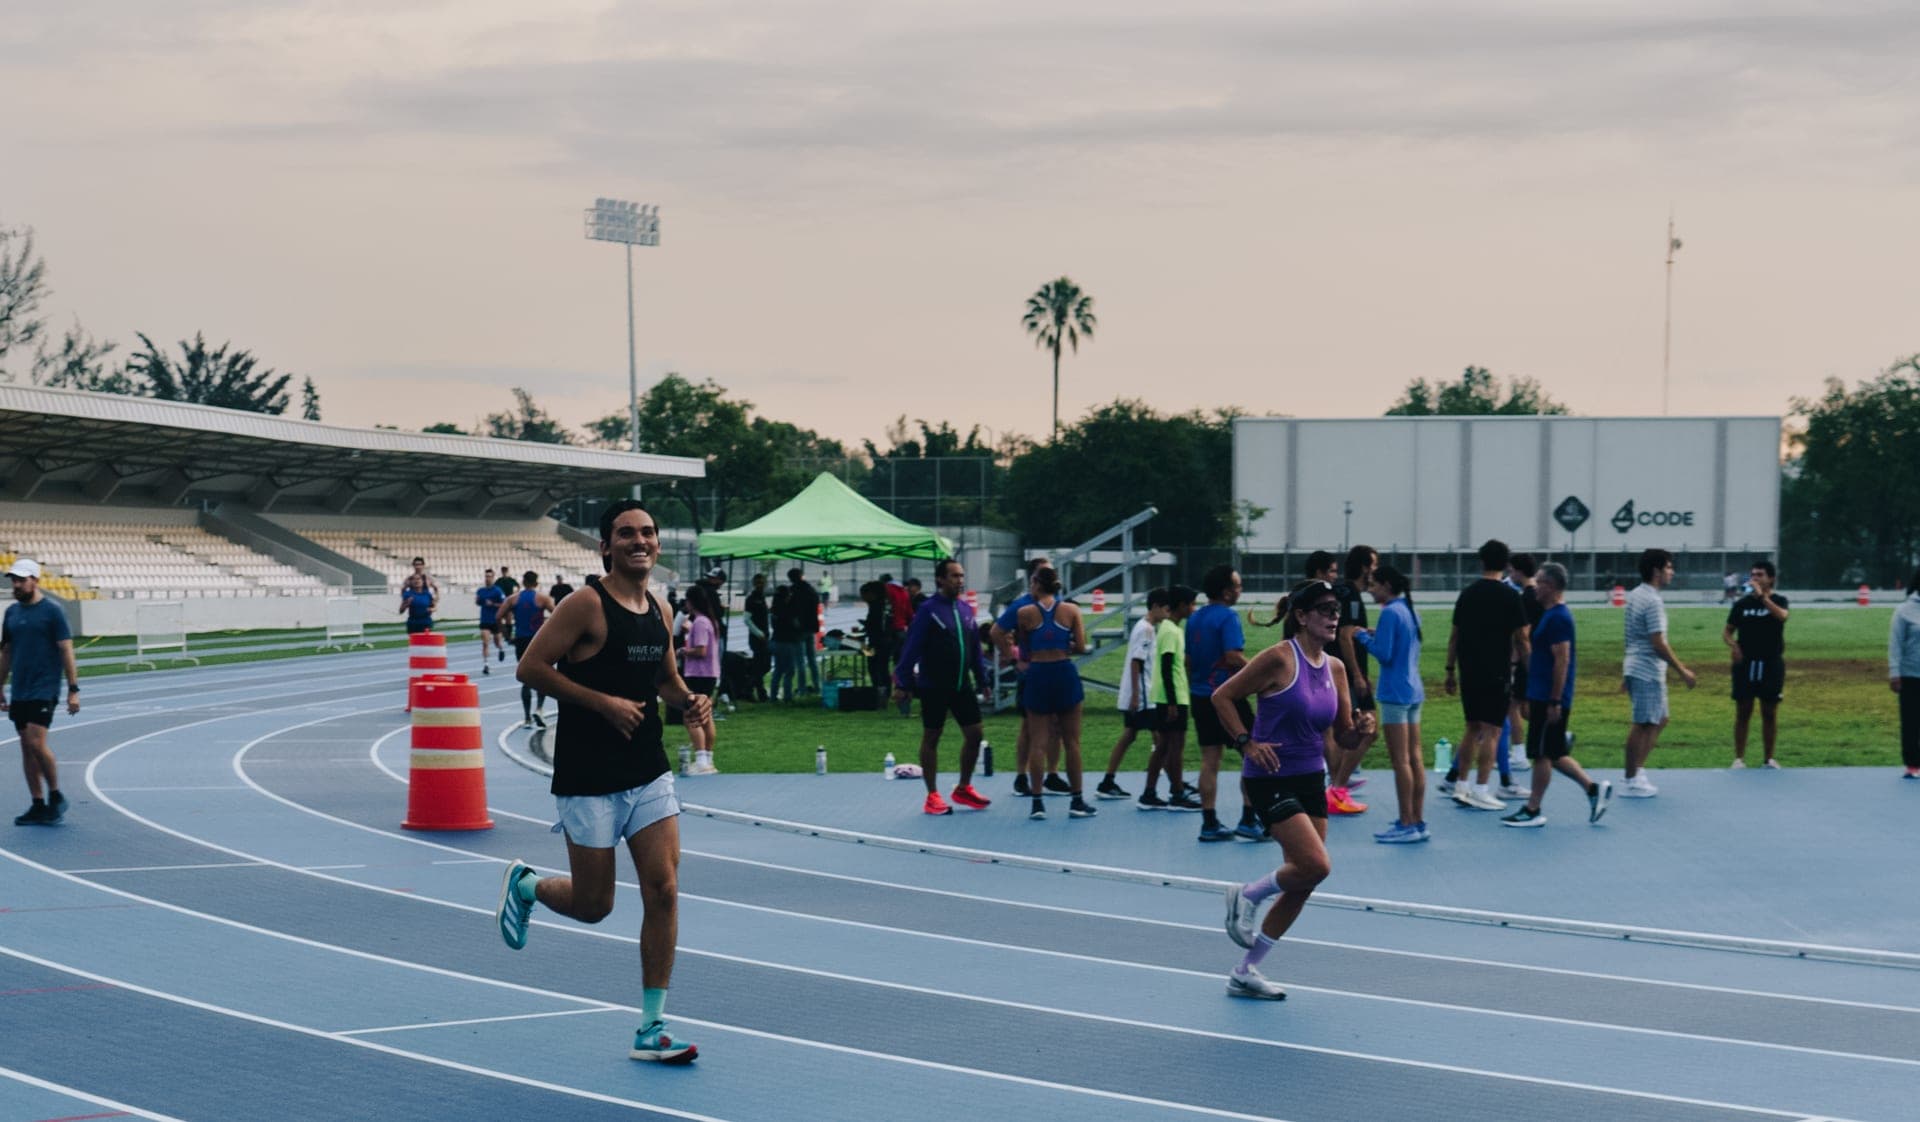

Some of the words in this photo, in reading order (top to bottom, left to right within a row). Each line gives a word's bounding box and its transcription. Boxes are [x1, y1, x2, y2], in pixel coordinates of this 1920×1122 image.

[1637, 511, 1694, 526] CODE
[627, 645, 648, 655] WAVE
[649, 645, 663, 655] ONE
